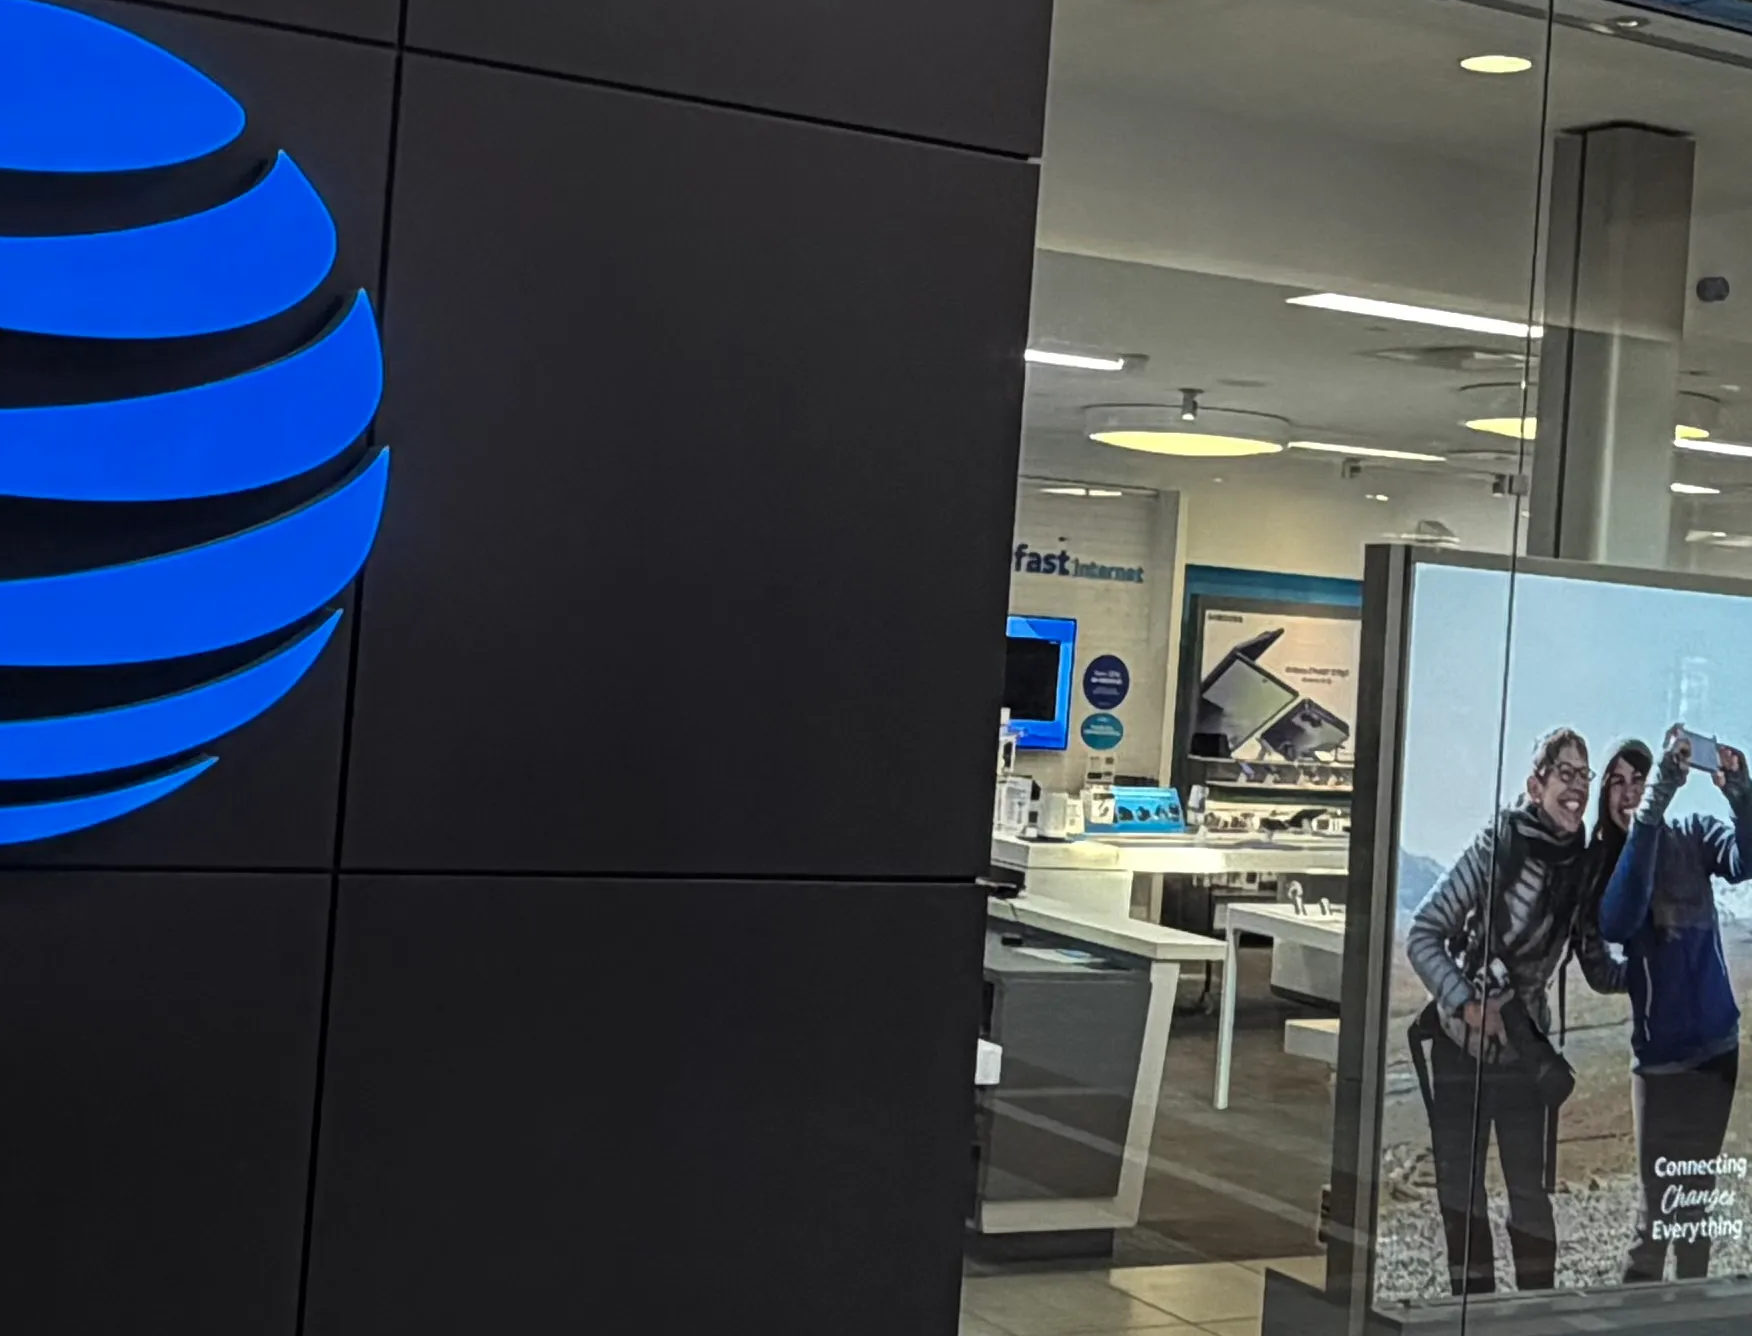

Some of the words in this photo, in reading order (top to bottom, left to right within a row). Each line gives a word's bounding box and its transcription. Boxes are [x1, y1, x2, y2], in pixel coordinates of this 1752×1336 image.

[1654, 1152, 1748, 1180] Connecting
[1660, 1184, 1737, 1215] Changes
[1651, 1214, 1744, 1244] Everything
